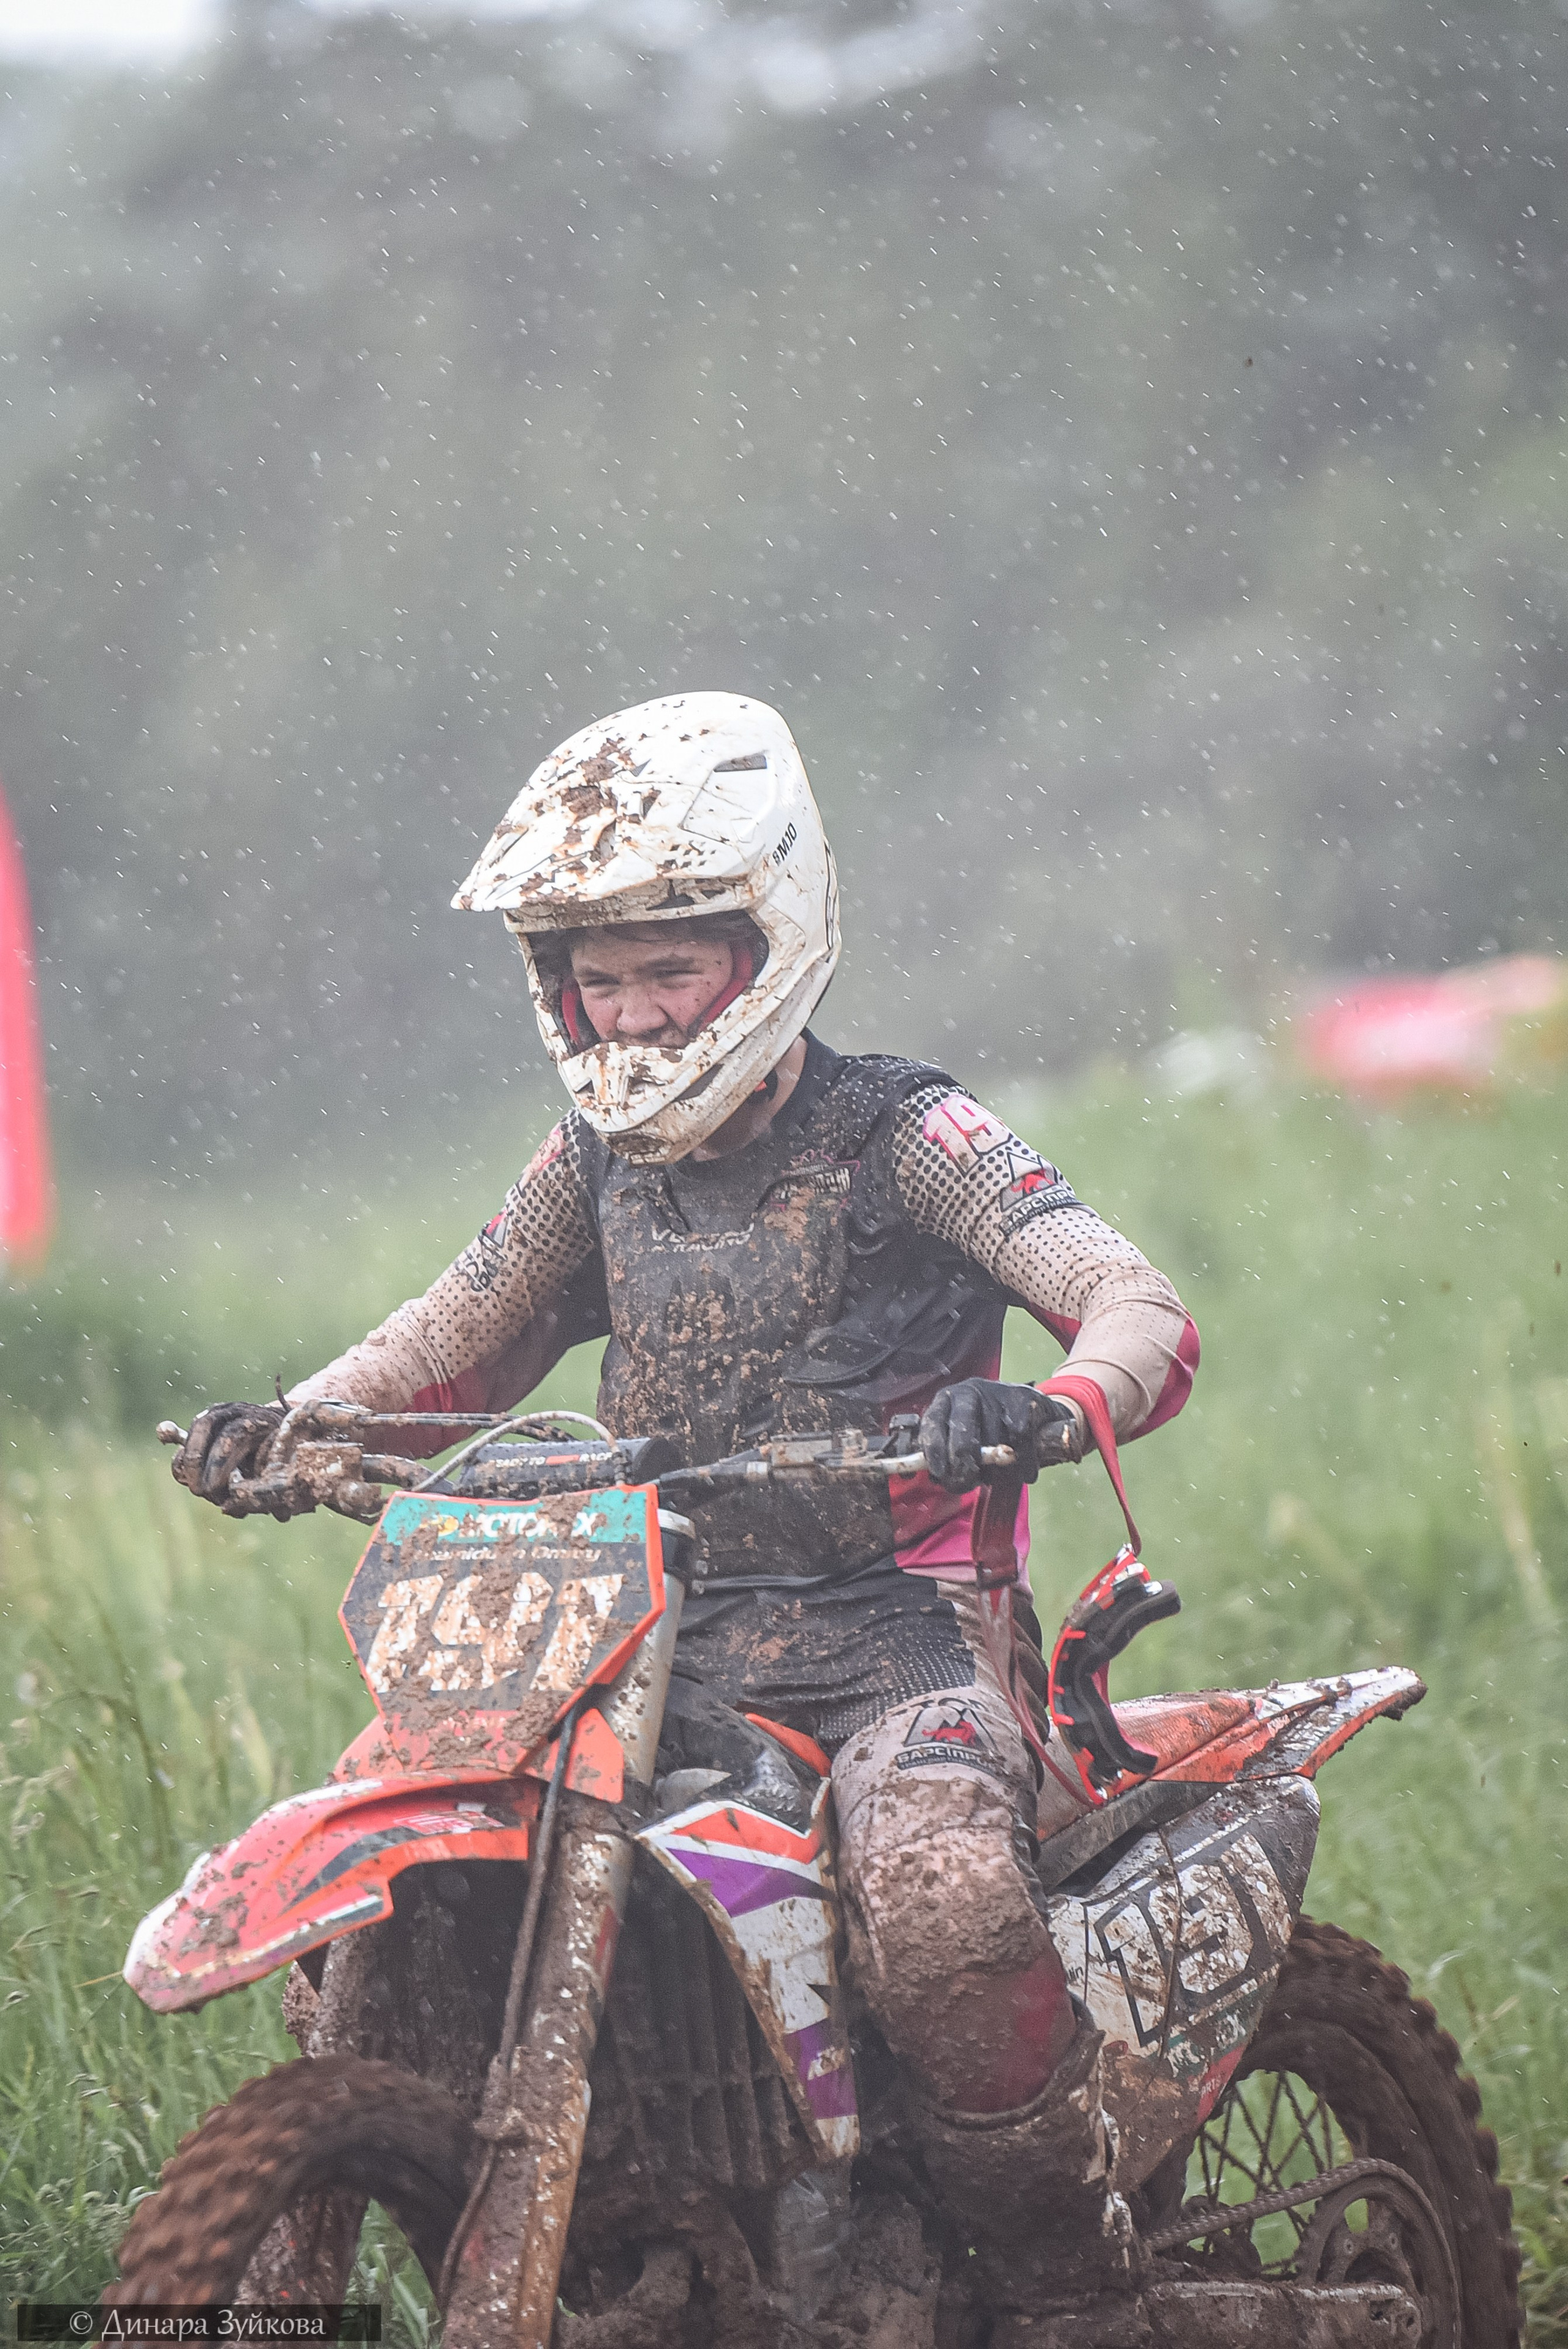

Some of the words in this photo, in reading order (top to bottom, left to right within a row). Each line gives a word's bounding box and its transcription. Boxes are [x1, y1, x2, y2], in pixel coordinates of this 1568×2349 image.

[924, 1095, 1012, 1177] 19
[529, 1456, 546, 1466] TO
[459, 1512, 598, 1537] MOTORX
